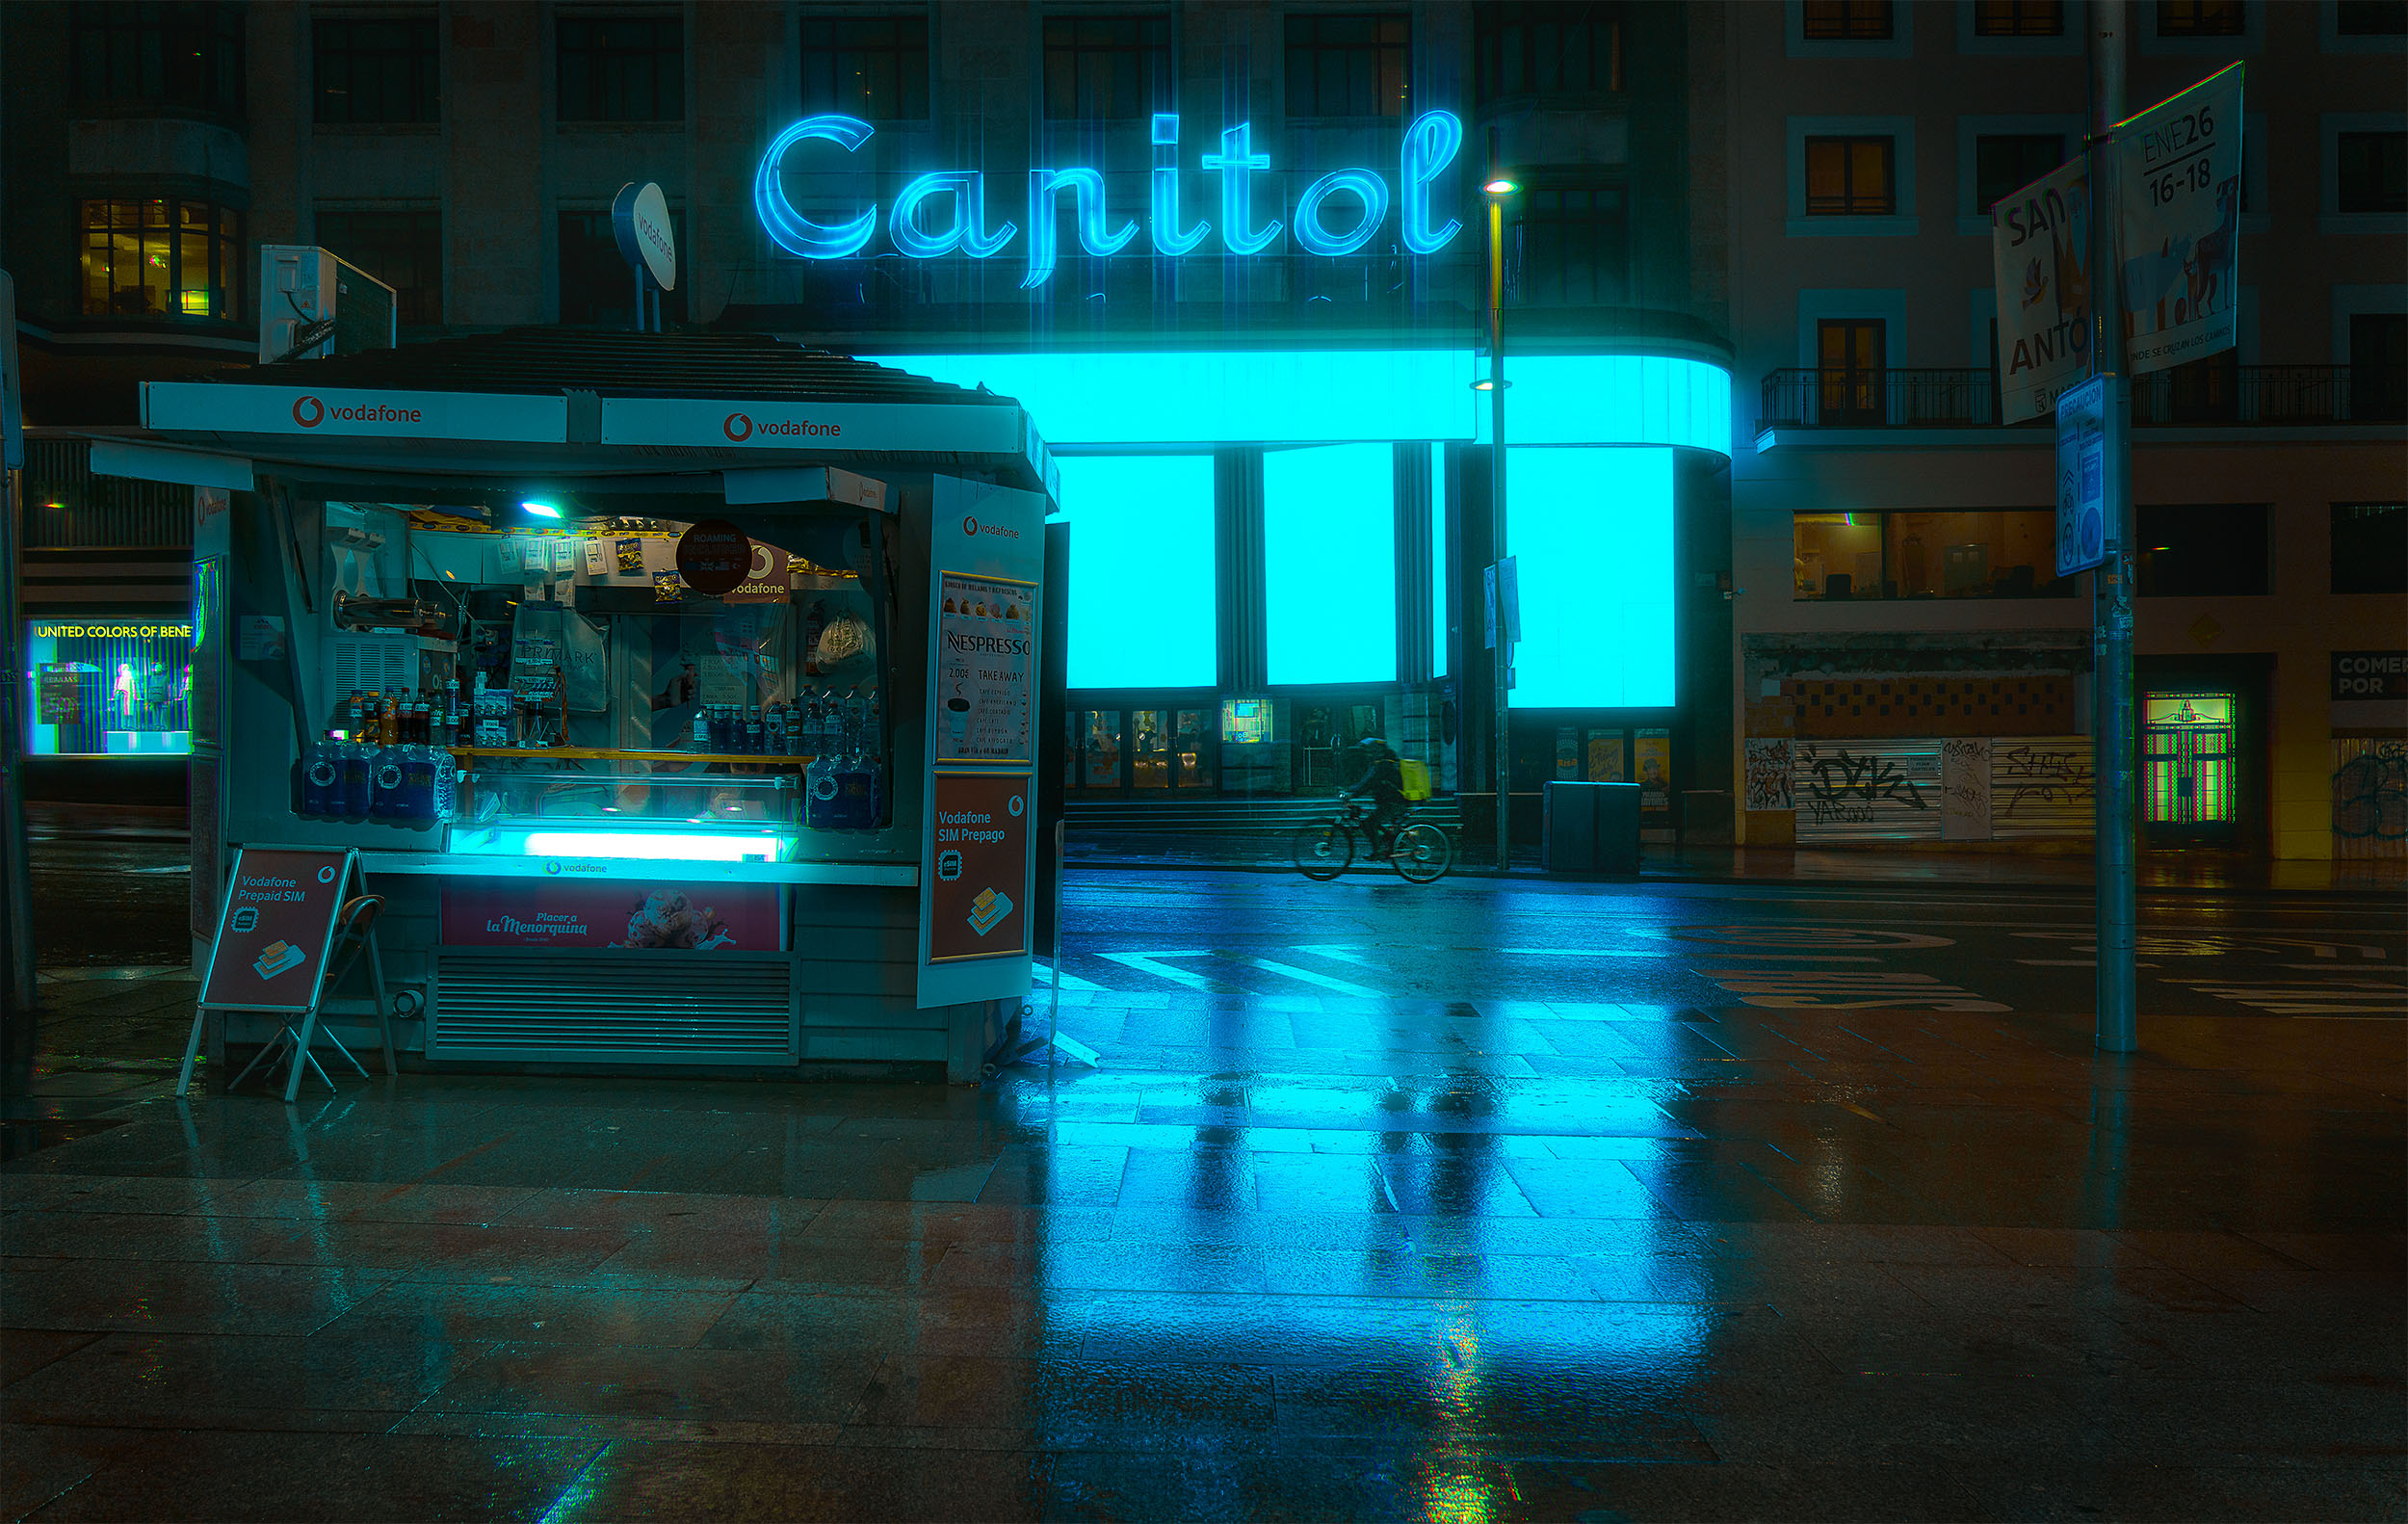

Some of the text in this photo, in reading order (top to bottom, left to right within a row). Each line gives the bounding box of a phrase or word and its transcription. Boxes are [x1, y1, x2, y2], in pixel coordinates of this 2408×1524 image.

[2142, 106, 2213, 163] ENE26
[2149, 158, 2212, 207] 16-18
[754, 109, 1463, 290] Capitol
[638, 211, 672, 263] vodafone
[2009, 306, 2088, 376] ANTÓ
[2152, 347, 2161, 357] SE
[2162, 338, 2189, 355] CRUZAN
[2190, 333, 2204, 347] LOS
[2205, 323, 2232, 343] CAMINOS
[330, 404, 422, 423] vodafone
[757, 420, 842, 436] vodafone
[694, 534, 737, 543] ROAMING
[979, 523, 1020, 539] vodafone
[38, 625, 193, 638] UNITED COLORS OF BENE
[947, 630, 1031, 655] NESPRESSO
[949, 668, 969, 678] 2.00€
[2339, 677, 2384, 694] POR
[938, 810, 991, 825] Vodafone
[938, 828, 1006, 844] SIM Prepago
[563, 863, 608, 873] vodafone
[242, 876, 297, 887] Vodafone
[238, 890, 305, 903] Prepaid SIM
[536, 912, 569, 922] Placer
[485, 915, 588, 936] la Menorquina
